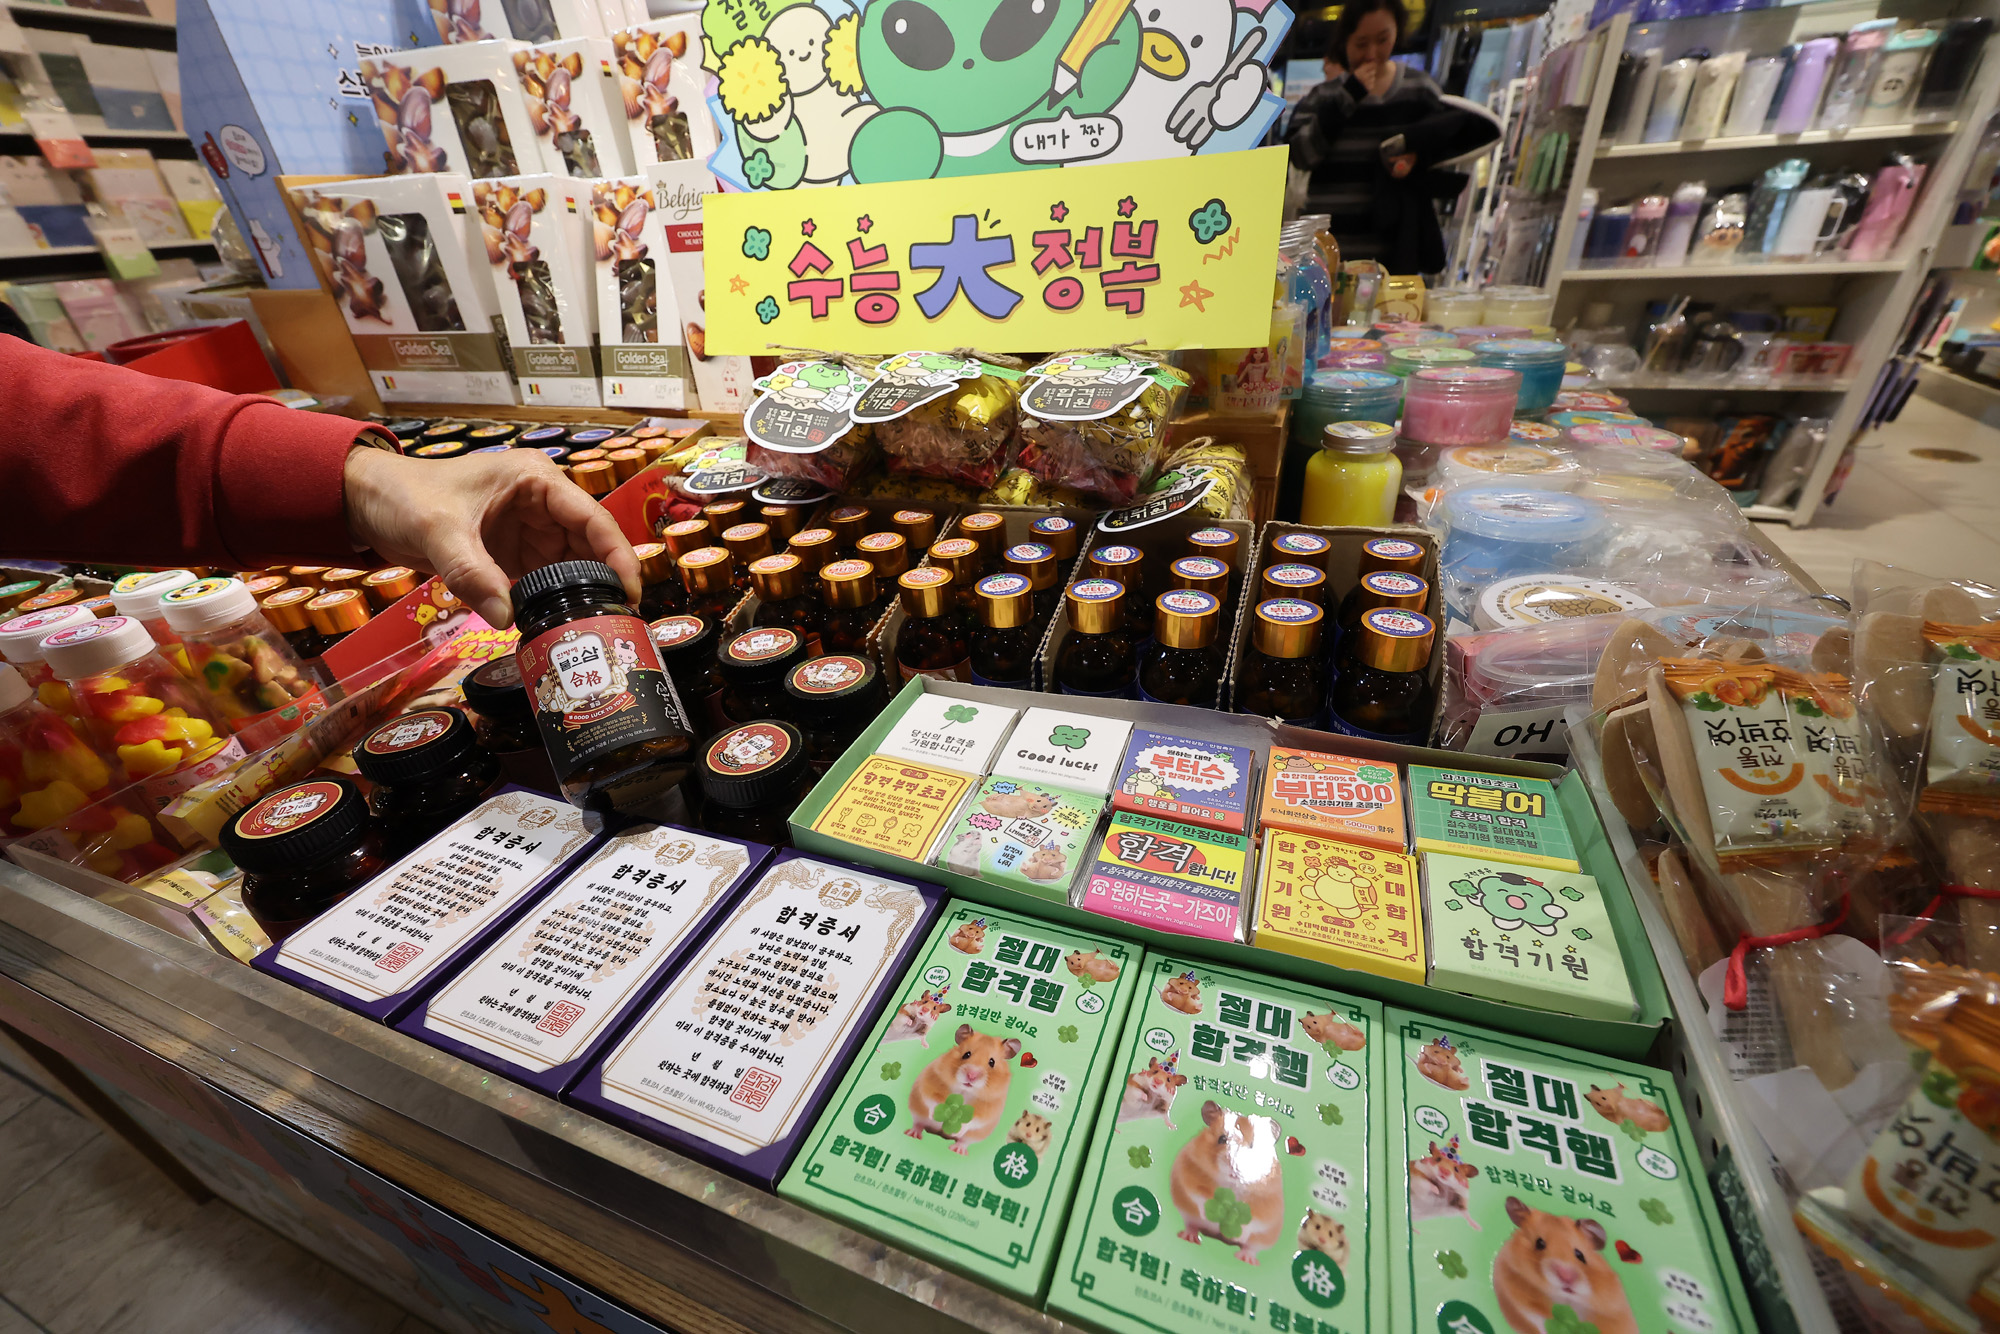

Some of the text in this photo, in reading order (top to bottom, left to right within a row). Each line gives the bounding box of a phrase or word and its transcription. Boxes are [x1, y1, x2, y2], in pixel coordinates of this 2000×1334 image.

[1023, 125, 1105, 152] 내가 짱
[787, 214, 1160, 324] 수능 大 정복
[395, 341, 452, 356] Golden Sea
[528, 353, 576, 365] Golden Sea
[617, 352, 666, 365] Golden Sea
[1054, 397, 1093, 409] 기원
[1057, 387, 1096, 398] 합격
[777, 409, 814, 426] 합격
[774, 423, 810, 440] 기원
[570, 670, 602, 688] 合格
[591, 709, 605, 719] LUCK
[613, 698, 624, 707] YOU
[911, 729, 975, 749] 당신의 합격을
[1704, 717, 1792, 747] 호박엿
[909, 738, 967, 756] 기원합니다!
[1166, 749, 1212, 762] 원하는 대학
[1736, 745, 1784, 768] 전통
[1017, 750, 1055, 764] Good
[1059, 757, 1099, 773] luck!
[1150, 753, 1225, 780] 부터스
[864, 772, 947, 802] 합격 부적 초코
[1168, 772, 1203, 785] 합격기원
[1441, 773, 1520, 790] 합격기원초코
[1275, 780, 1393, 805] 부터500
[1300, 799, 1383, 810] 소원성취기원 초콜릿
[1429, 782, 1544, 817] 딱붙어
[1148, 799, 1211, 818] 행운을 빌어요
[1270, 807, 1395, 834] 두뇌회전상승 집중력 500mg 함유
[1451, 810, 1527, 829] 초강력 합격
[474, 826, 542, 855] 합격증서
[1119, 813, 1240, 847] 합격기원/만점신화
[1447, 820, 1536, 839] 점수폭등 절대합격
[1448, 829, 1538, 849] 만점기원 행운폭발
[1118, 832, 1196, 873] 합격
[1322, 843, 1358, 856] 합격한다
[611, 864, 687, 895] 합격증서
[1149, 875, 1186, 891] 절대합격
[1188, 862, 1237, 886] 합니다!
[1464, 867, 1493, 880] 굿럭투유
[830, 887, 851, 898] 合格
[775, 905, 861, 943] 합격증서
[1303, 921, 1376, 943] 대박예감! 행운초코
[750, 927, 853, 965] 위 사람은 밤낮없이 공부하고,
[758, 942, 828, 971] 남다른 노력과 집념,
[994, 935, 1062, 974] 절대
[1461, 935, 1589, 981] 합격기원
[717, 957, 749, 973] 누구보다
[750, 967, 776, 981] 뛰어난
[777, 975, 801, 990] 실력을
[746, 952, 824, 983] 뜨거운 열정과 열의로
[708, 969, 830, 1016] 매시간 노력과 최선을 다했습니다.
[961, 961, 1065, 1014] 합격햄
[704, 982, 816, 1027] 평소보다 더 높은 점수를 받아
[707, 998, 790, 1033] 틀림없이 원하는 곳에
[1219, 992, 1292, 1040] 절대
[708, 1015, 772, 1044] 합격할 것이기에
[956, 1003, 1039, 1039] 합격길만 걸어요
[675, 1019, 785, 1068] 미리 이 합격증을 수여합니다.
[657, 1059, 734, 1096] 원하는 곳에 합격하장
[691, 1051, 745, 1079] 년 월 일
[688, 1095, 698, 1105] Net
[697, 1099, 716, 1114] Wt.40g
[1485, 1062, 1579, 1120] 절대
[863, 1103, 1029, 1181] 合 格
[1467, 1101, 1619, 1181] 합격햄
[829, 1134, 1031, 1229] 합격햄! 축하햄! 행복햄!
[1485, 1165, 1617, 1218] 합격길만 걸어요
[1121, 1197, 1336, 1298] 合 格
[1096, 1236, 1258, 1321] 합격햄! 축하햄!
